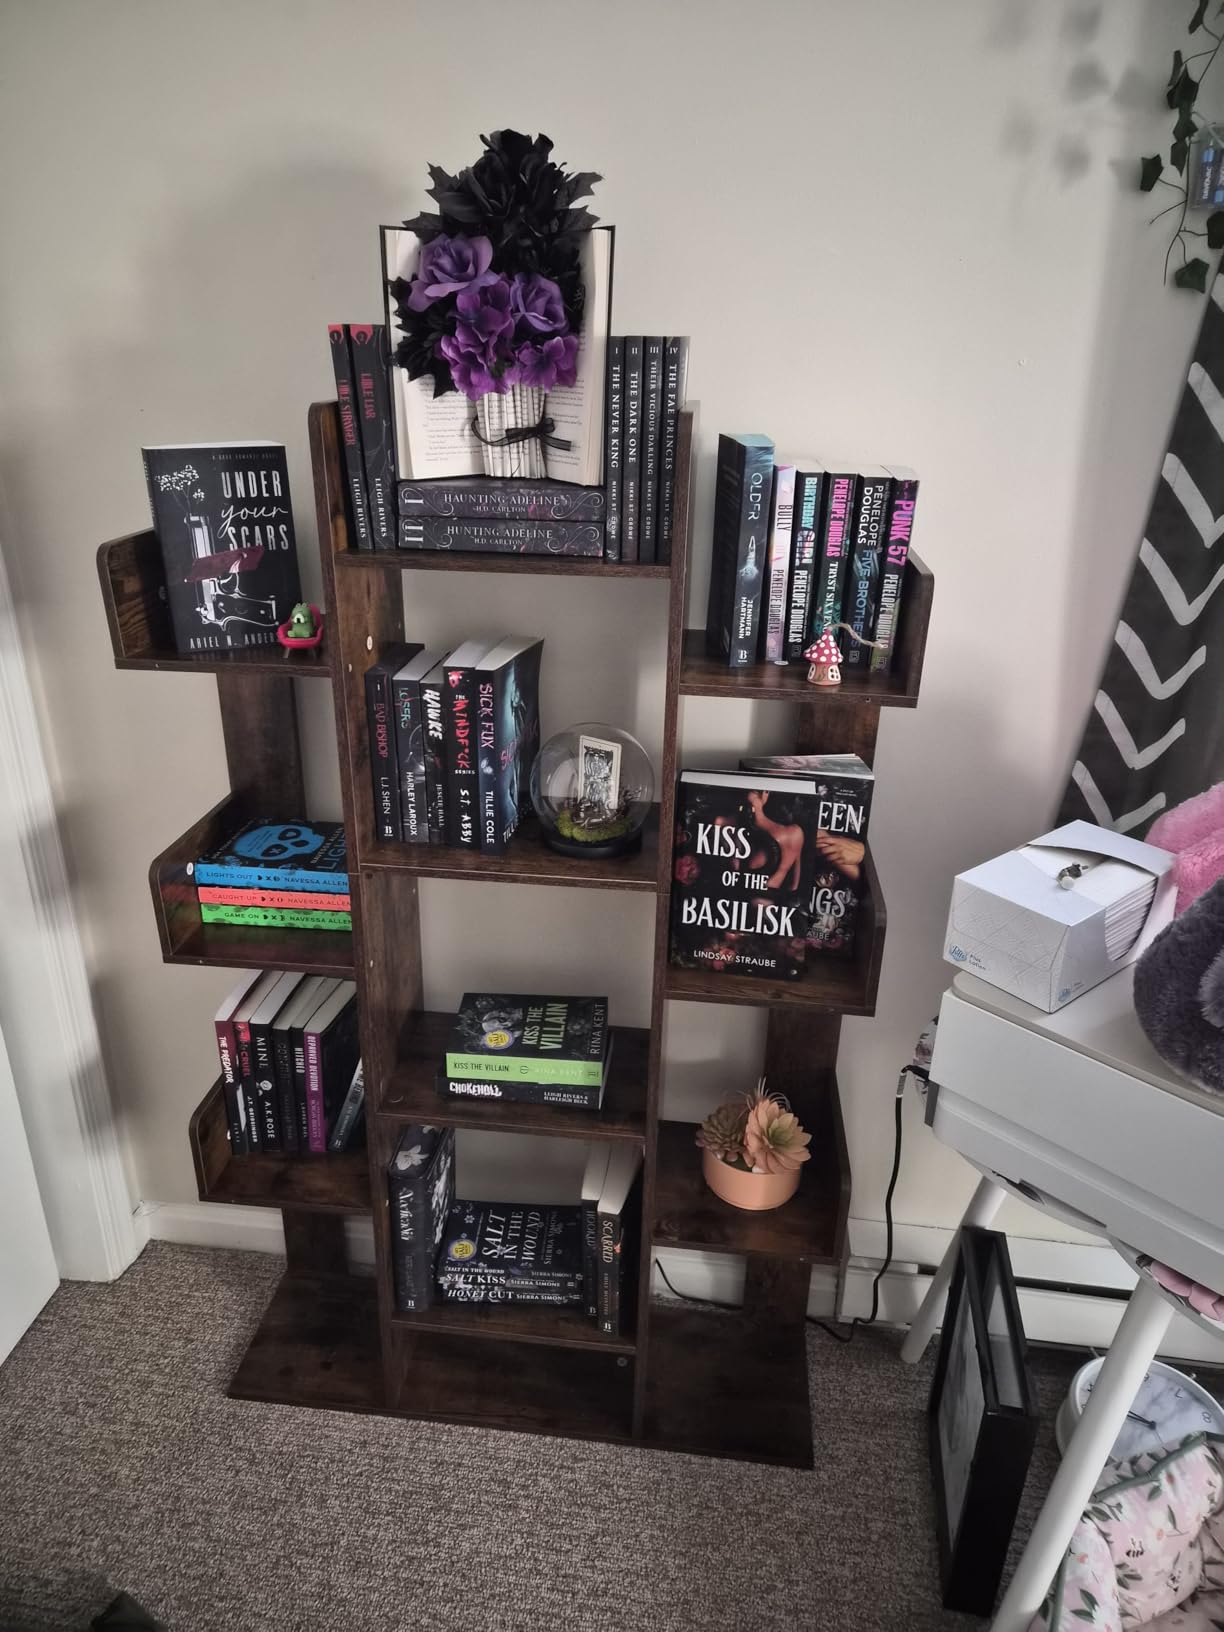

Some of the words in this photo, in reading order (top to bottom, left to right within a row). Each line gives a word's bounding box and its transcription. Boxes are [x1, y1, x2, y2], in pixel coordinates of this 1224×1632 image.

[612, 364, 620, 390] THE
[630, 372, 638, 396] THE
[668, 364, 677, 388] THE
[612, 394, 620, 434] NEVER
[630, 401, 638, 434] DARK
[648, 394, 656, 432] VICIOUS
[668, 394, 676, 414] FAE
[611, 438, 619, 468] KING
[628, 438, 637, 463] ONE
[666, 420, 674, 470] PRINCES
[221, 470, 282, 498] UNDER
[375, 478, 384, 504] LEIGH
[748, 472, 763, 520] OLDER
[831, 479, 849, 518] PENELOPE
[353, 478, 362, 504] LEIGH
[358, 508, 366, 538] RIVERS
[444, 494, 505, 504] HAUNTING
[510, 495, 560, 506] ADELINE
[802, 477, 818, 529] BIRTHDAY
[218, 505, 288, 539] your
[378, 508, 387, 537] RIVERS
[777, 504, 792, 531] BULLY
[858, 487, 873, 544] DOUGLAS
[867, 486, 884, 546] PENELOPE
[890, 500, 914, 541] PUNK
[228, 524, 288, 550] SCARS
[447, 526, 500, 537] HUNTING
[504, 528, 552, 539] ADELINE
[490, 538, 523, 546] CARLTON
[826, 520, 844, 557] DOUGLAS
[860, 550, 872, 577] FIVE
[886, 546, 908, 566] 57
[771, 570, 784, 603] PENELOPE
[792, 570, 808, 608] PENELOPE
[827, 562, 838, 592] TRYST
[825, 592, 834, 608] SIX
[880, 574, 899, 612] PENELOPE
[738, 597, 748, 638] HARTMANN
[745, 600, 754, 636] JENNIFER
[768, 604, 781, 634] DOUGLAS
[788, 609, 804, 642] DOUGLAS
[190, 635, 220, 650] ARIEL
[376, 703, 386, 722] BAD
[400, 688, 411, 729] LOSERS
[423, 690, 443, 740] HAWKE
[480, 684, 494, 718] SICK
[376, 724, 388, 758] BISHOP
[481, 722, 494, 749] FUX
[406, 772, 416, 802] HARLEY
[382, 790, 391, 814] SHEN
[486, 790, 494, 818] TILLIE
[408, 804, 418, 836] LAROUX
[486, 820, 495, 844] COLE
[818, 801, 864, 834] EEN
[696, 822, 751, 859] KISS
[722, 871, 739, 887] OF
[744, 873, 770, 891] THE
[288, 898, 324, 906] NAVESSA
[682, 897, 796, 937] BASILISK
[694, 950, 732, 962] LINDSAY
[735, 955, 776, 968] STRAUBE
[526, 1006, 544, 1023] THE
[539, 1003, 568, 1050] VILLAIN
[592, 1004, 605, 1030] KENT
[218, 1036, 227, 1050] THE
[307, 1036, 317, 1064] DEPRAVED
[522, 1026, 542, 1045] KISS
[590, 1031, 603, 1054] RINA
[220, 1050, 234, 1084] PREDATOR
[241, 1051, 250, 1077] CRUEL
[256, 1036, 269, 1069] MINE
[454, 1062, 468, 1070] KISS
[309, 1065, 318, 1091] DEVOTION
[482, 1210, 507, 1258] SALT
[507, 1211, 524, 1240] THE
[521, 1211, 542, 1261] WOUND
[503, 1244, 518, 1260] IN
[602, 1220, 613, 1263] SCARRED
[446, 1273, 474, 1283] SALT
[478, 1275, 506, 1284] KISS
[536, 1280, 560, 1288] SIMONE
[448, 1289, 487, 1298] HONEY
[488, 1290, 514, 1300] CUT
